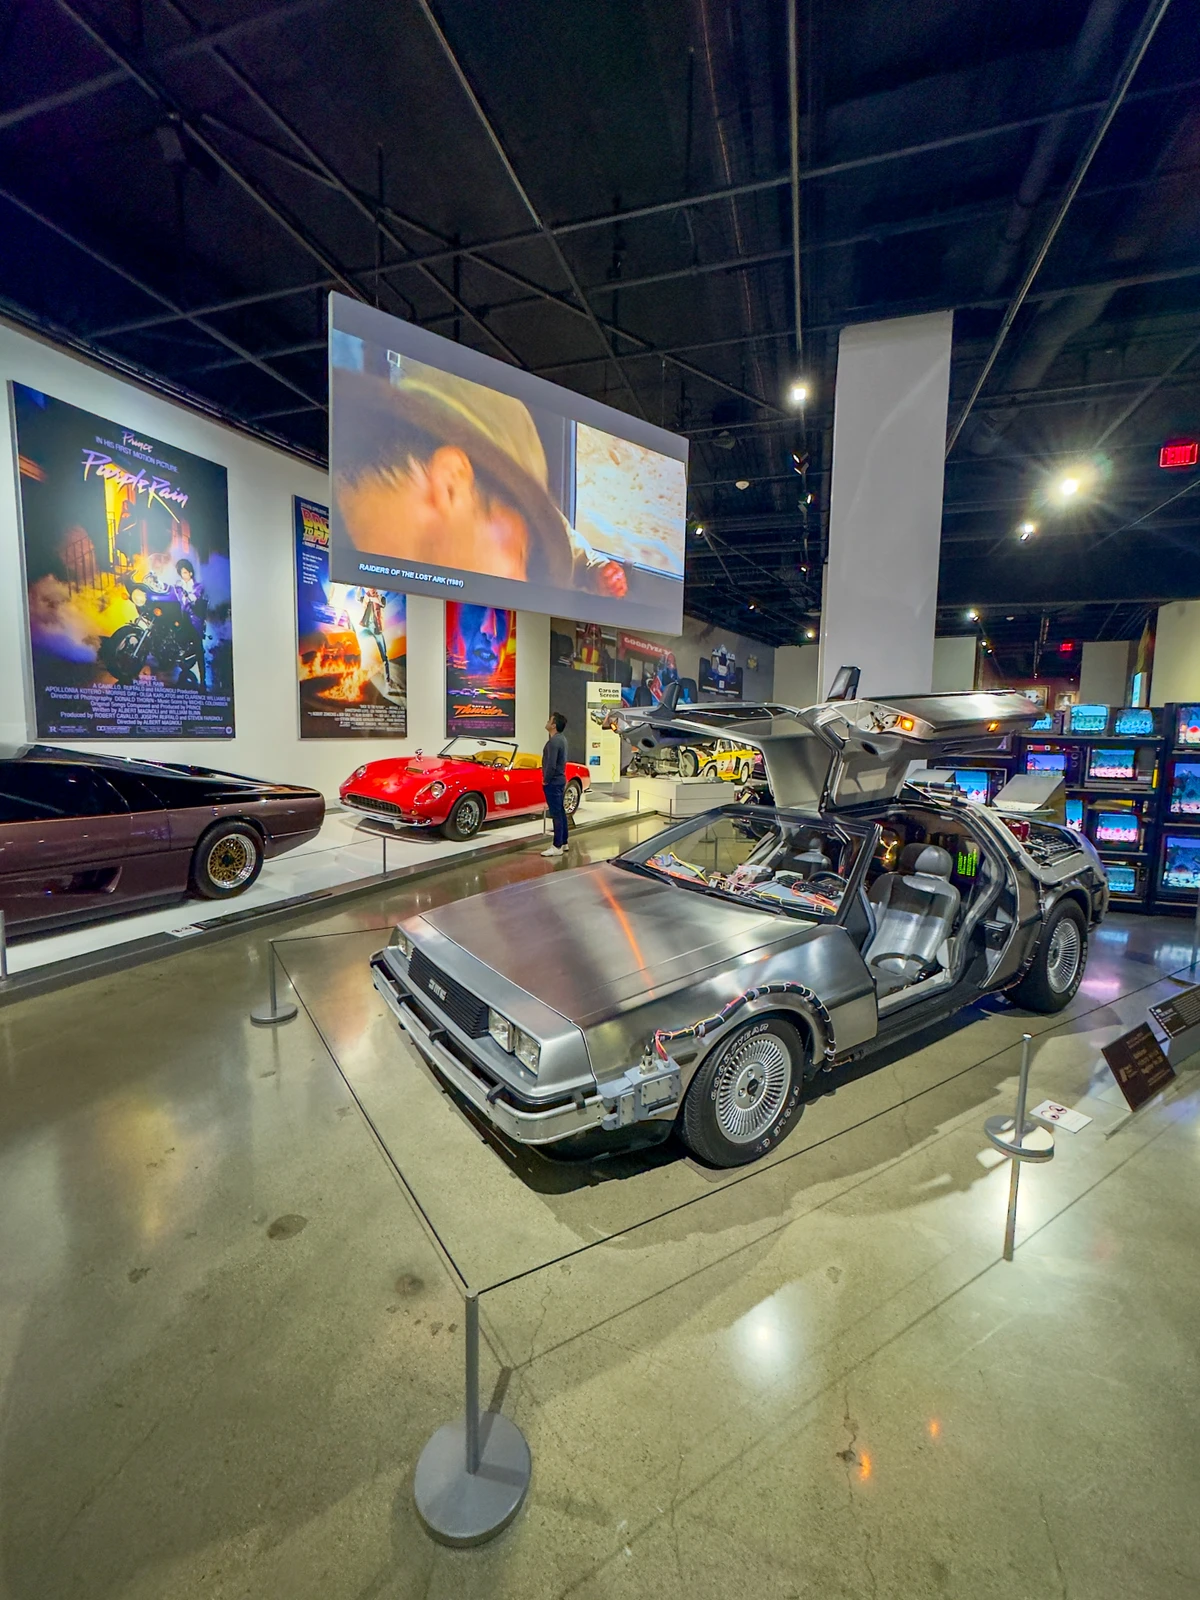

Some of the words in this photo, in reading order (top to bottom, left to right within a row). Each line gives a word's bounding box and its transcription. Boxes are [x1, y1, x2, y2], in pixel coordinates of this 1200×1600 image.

[95, 435, 103, 444] IN
[104, 439, 114, 449] HIS
[115, 442, 132, 455] FIRST
[132, 450, 155, 465] MOTION
[122, 430, 153, 453] Prince
[81, 448, 149, 494] Purple
[147, 475, 188, 523] Rain
[301, 507, 330, 534] BAC
[359, 563, 390, 575] RAIDERS
[390, 568, 400, 576] OF
[401, 570, 415, 578] THE
[415, 572, 432, 581] LOST
[432, 575, 446, 584] ARK
[710, 1023, 769, 1101] GOODYEAR
[773, 1086, 800, 1137] EAGLE
